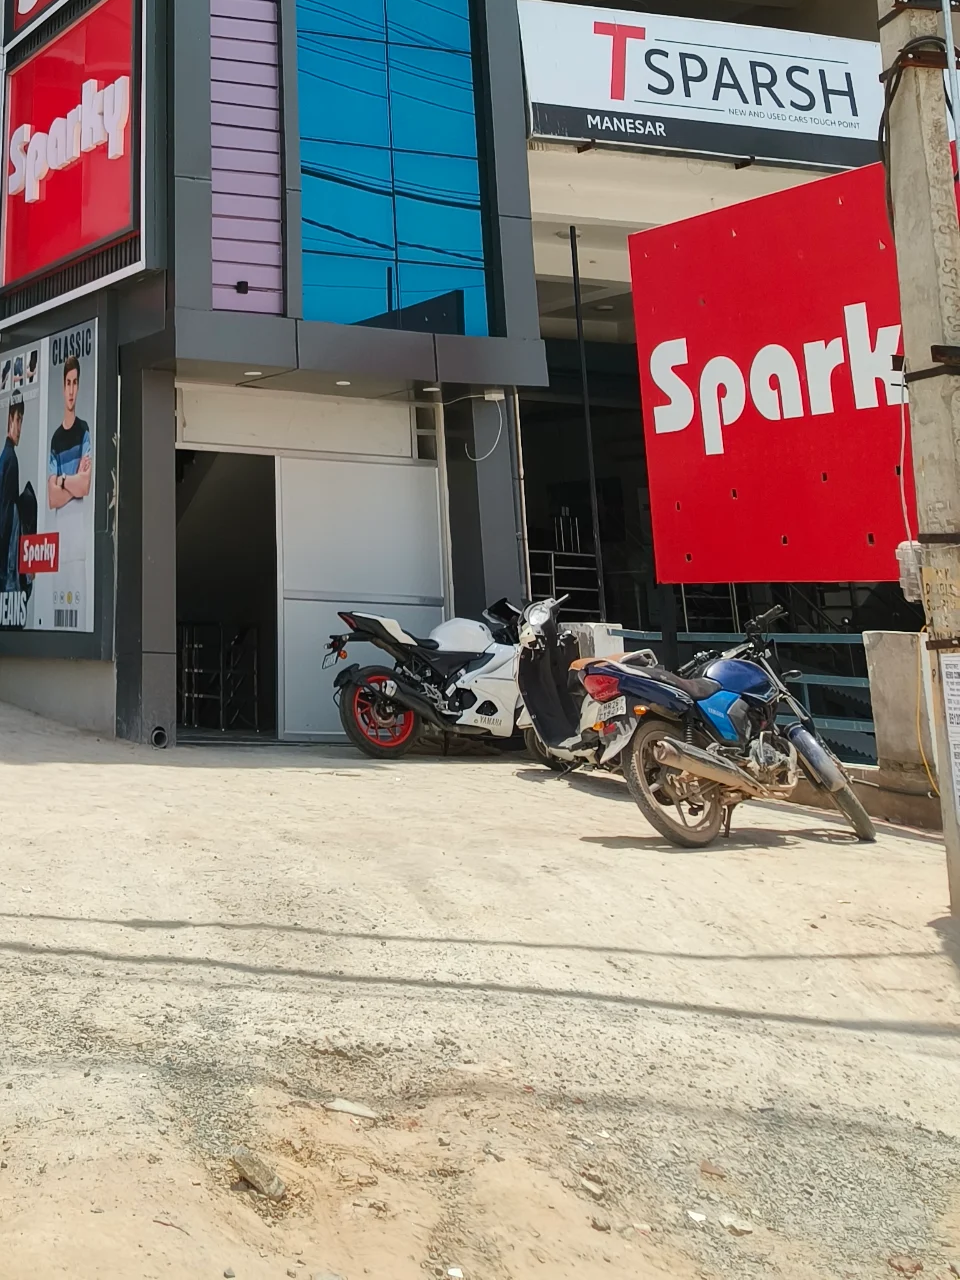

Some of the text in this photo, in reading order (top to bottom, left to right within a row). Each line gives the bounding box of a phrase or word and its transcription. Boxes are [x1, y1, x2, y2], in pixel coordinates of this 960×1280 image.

[586, 114, 666, 137] MANESAR
[728, 108, 860, 130] NEW AND USED CARS TOUCH POINT
[9, 75, 130, 203] Sparky
[52, 327, 91, 366] CLASSIC
[649, 302, 908, 455] Spark
[23, 536, 56, 566] Sparky
